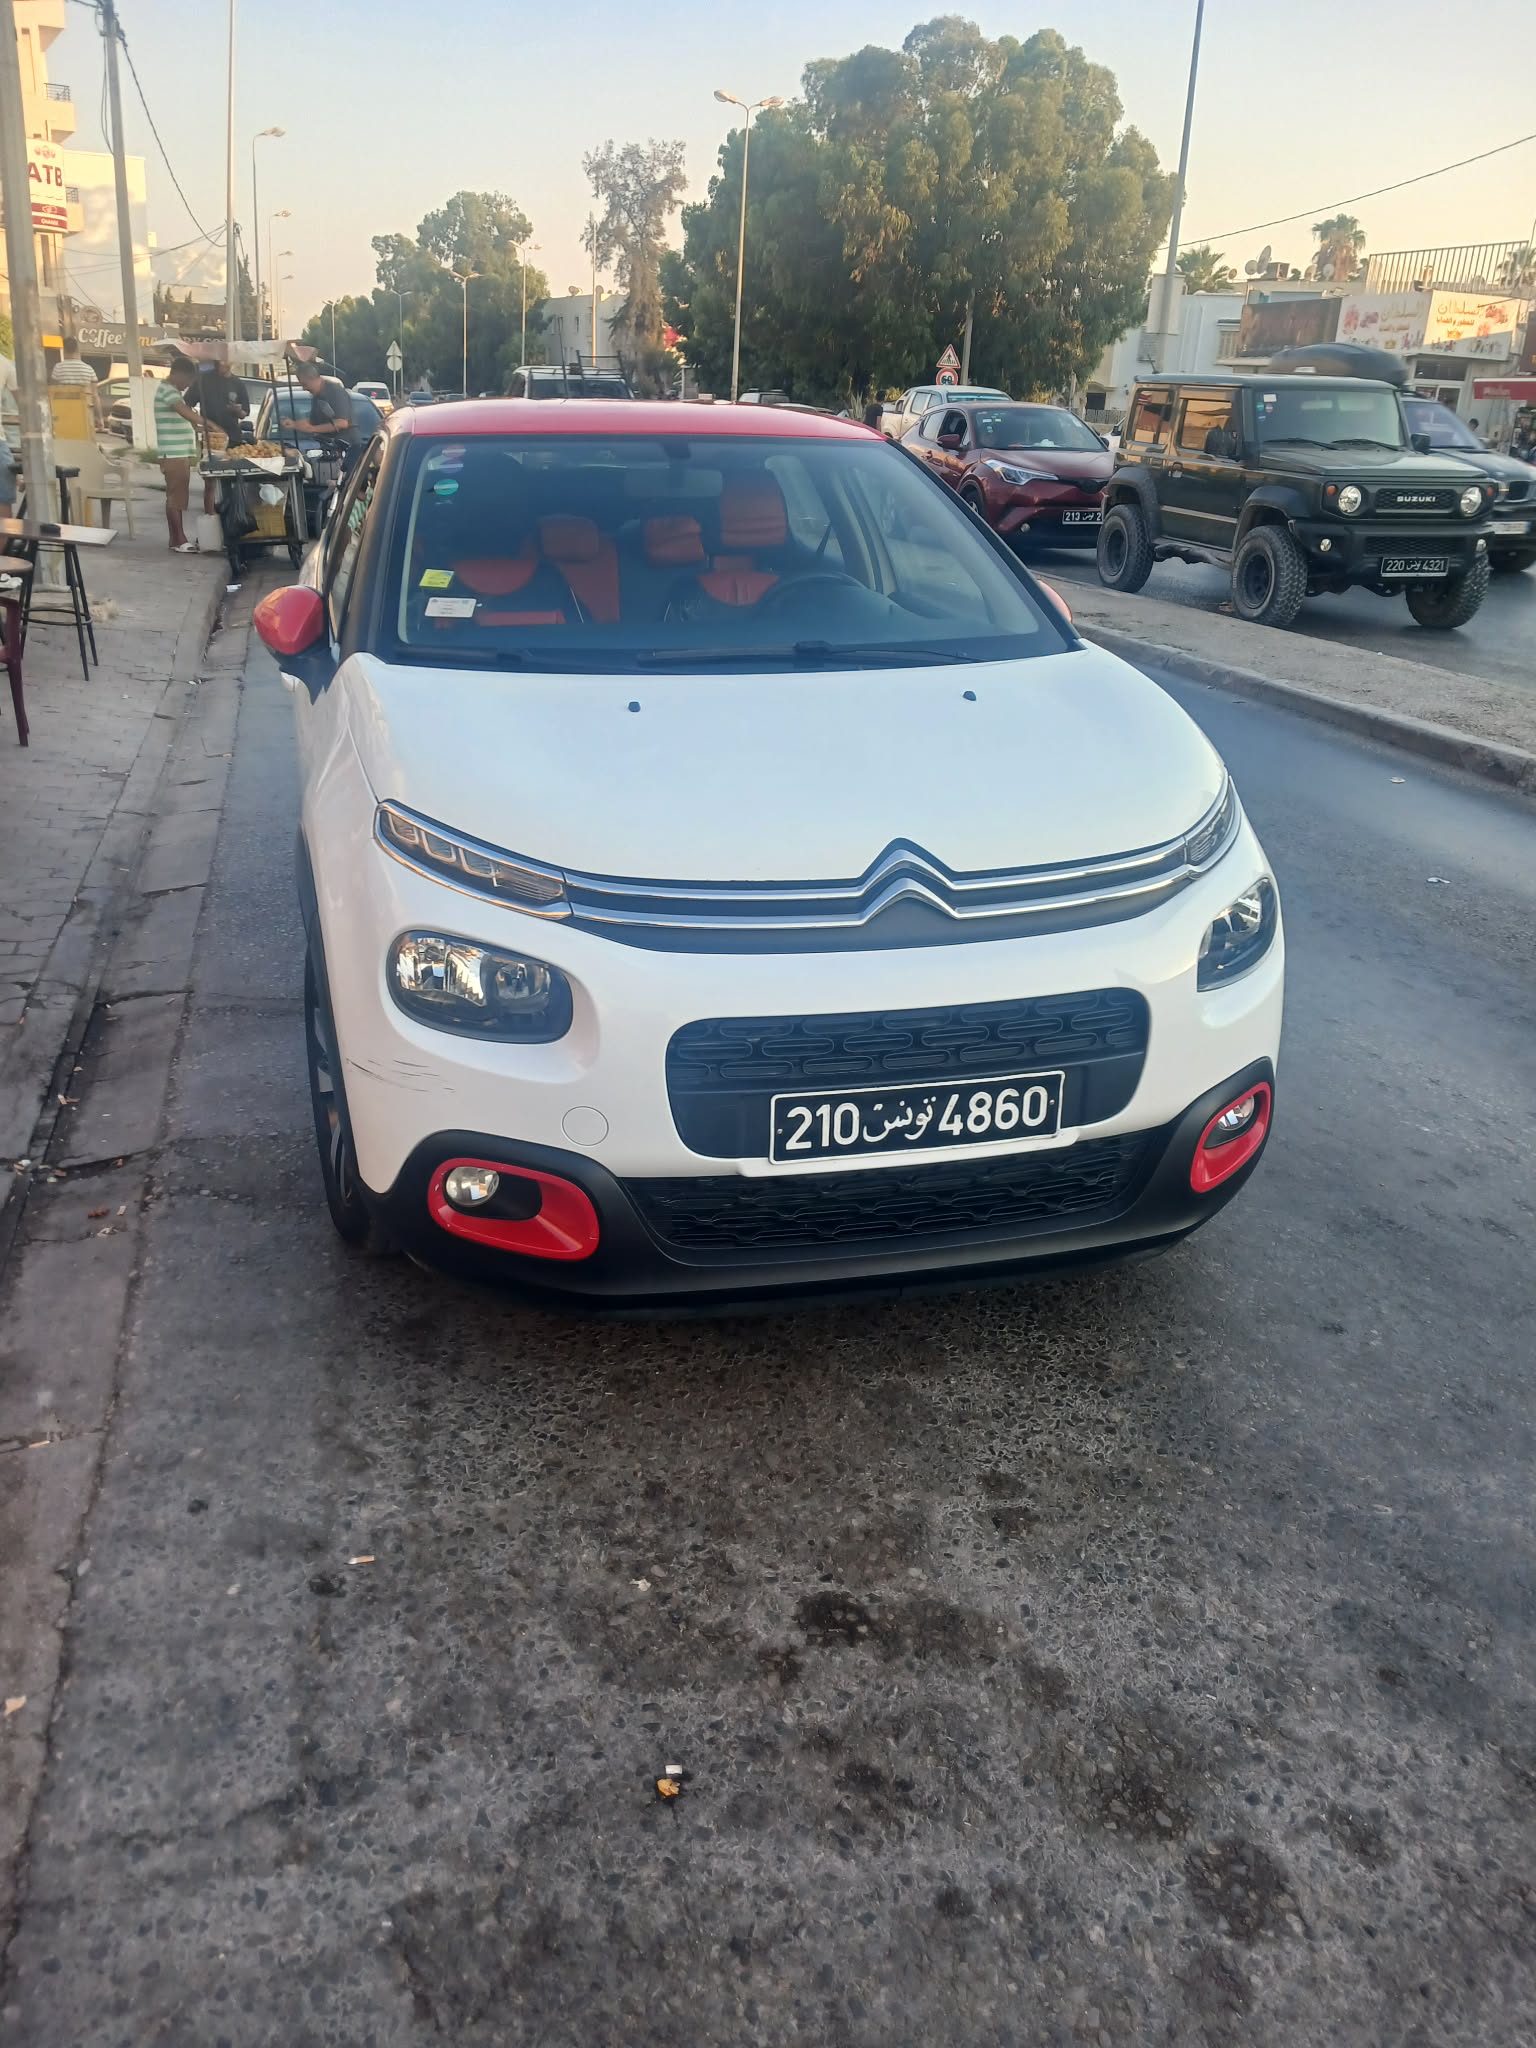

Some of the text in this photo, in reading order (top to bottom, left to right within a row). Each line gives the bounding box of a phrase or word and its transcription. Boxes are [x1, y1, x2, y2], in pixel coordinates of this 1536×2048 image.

[28, 162, 63, 187] ATB
[1065, 511, 1081, 521] 213
[1386, 559, 1445, 571] 220 تونس 4321
[785, 1085, 1049, 1151] 210 تونس 4860
